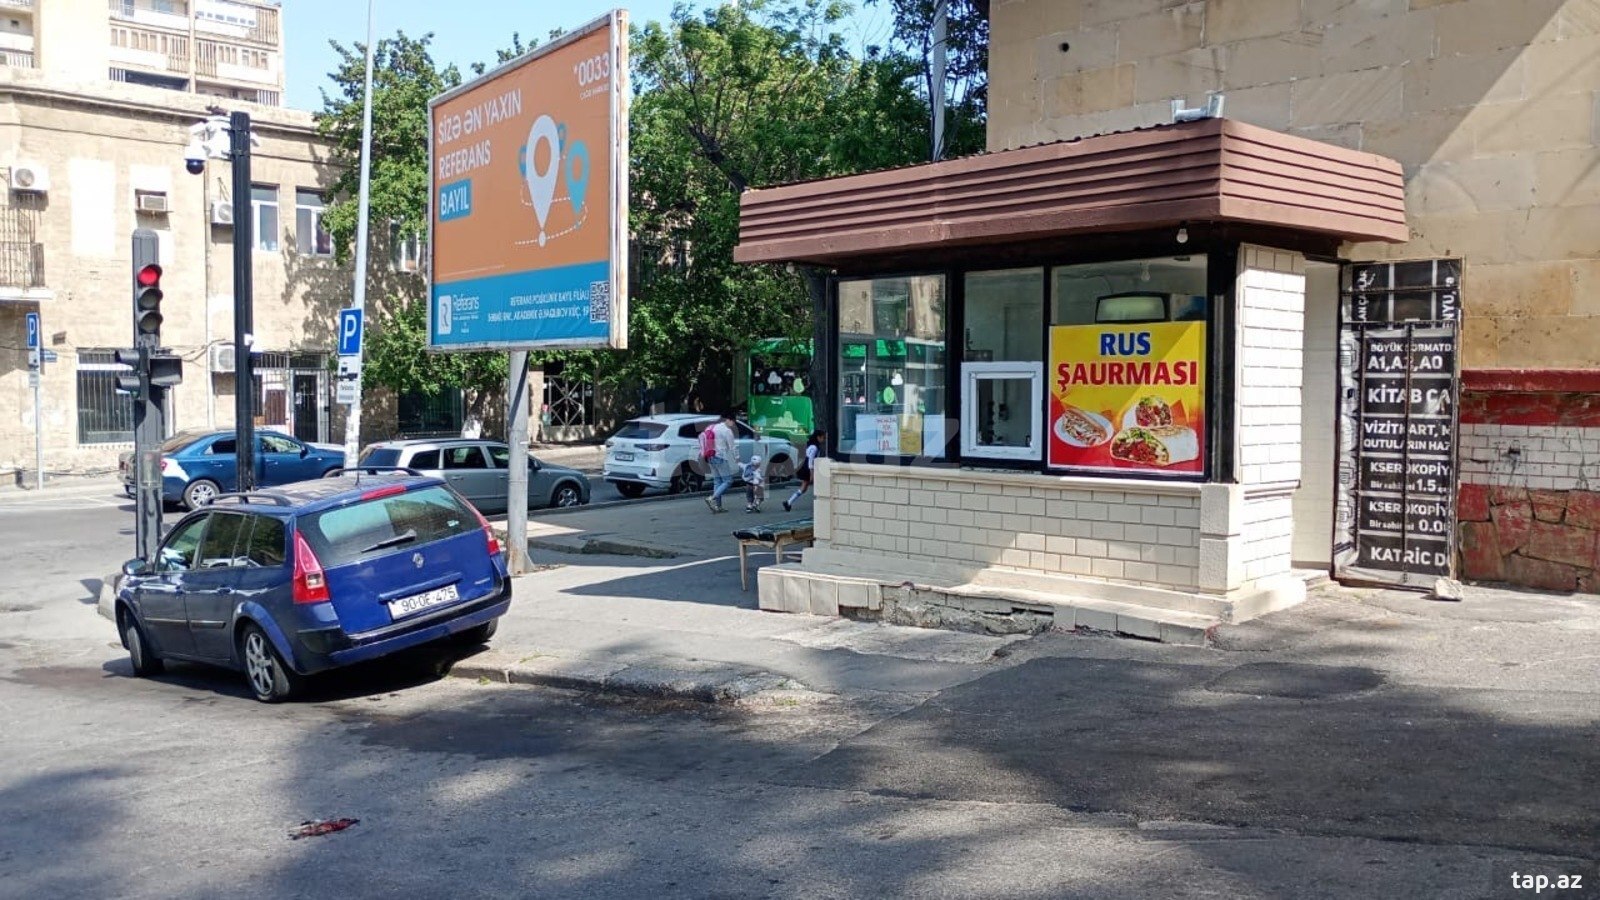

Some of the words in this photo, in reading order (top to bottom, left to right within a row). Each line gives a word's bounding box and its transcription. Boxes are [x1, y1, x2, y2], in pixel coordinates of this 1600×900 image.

[439, 114, 461, 145] SİZƏ
[463, 105, 482, 135] ƏN
[484, 88, 521, 126] YAXIN
[439, 139, 491, 180] REFERANS
[441, 185, 470, 216] BAYIL
[29, 317, 36, 344] P
[344, 315, 357, 349] P
[1100, 332, 1151, 356] RUS
[1370, 342, 1403, 352] BÖYÜK
[1057, 361, 1197, 392] ŞAURMASI
[1368, 384, 1422, 403] KİTAB
[1416, 478, 1437, 492] 1.5
[1370, 546, 1431, 566] KATRİC
